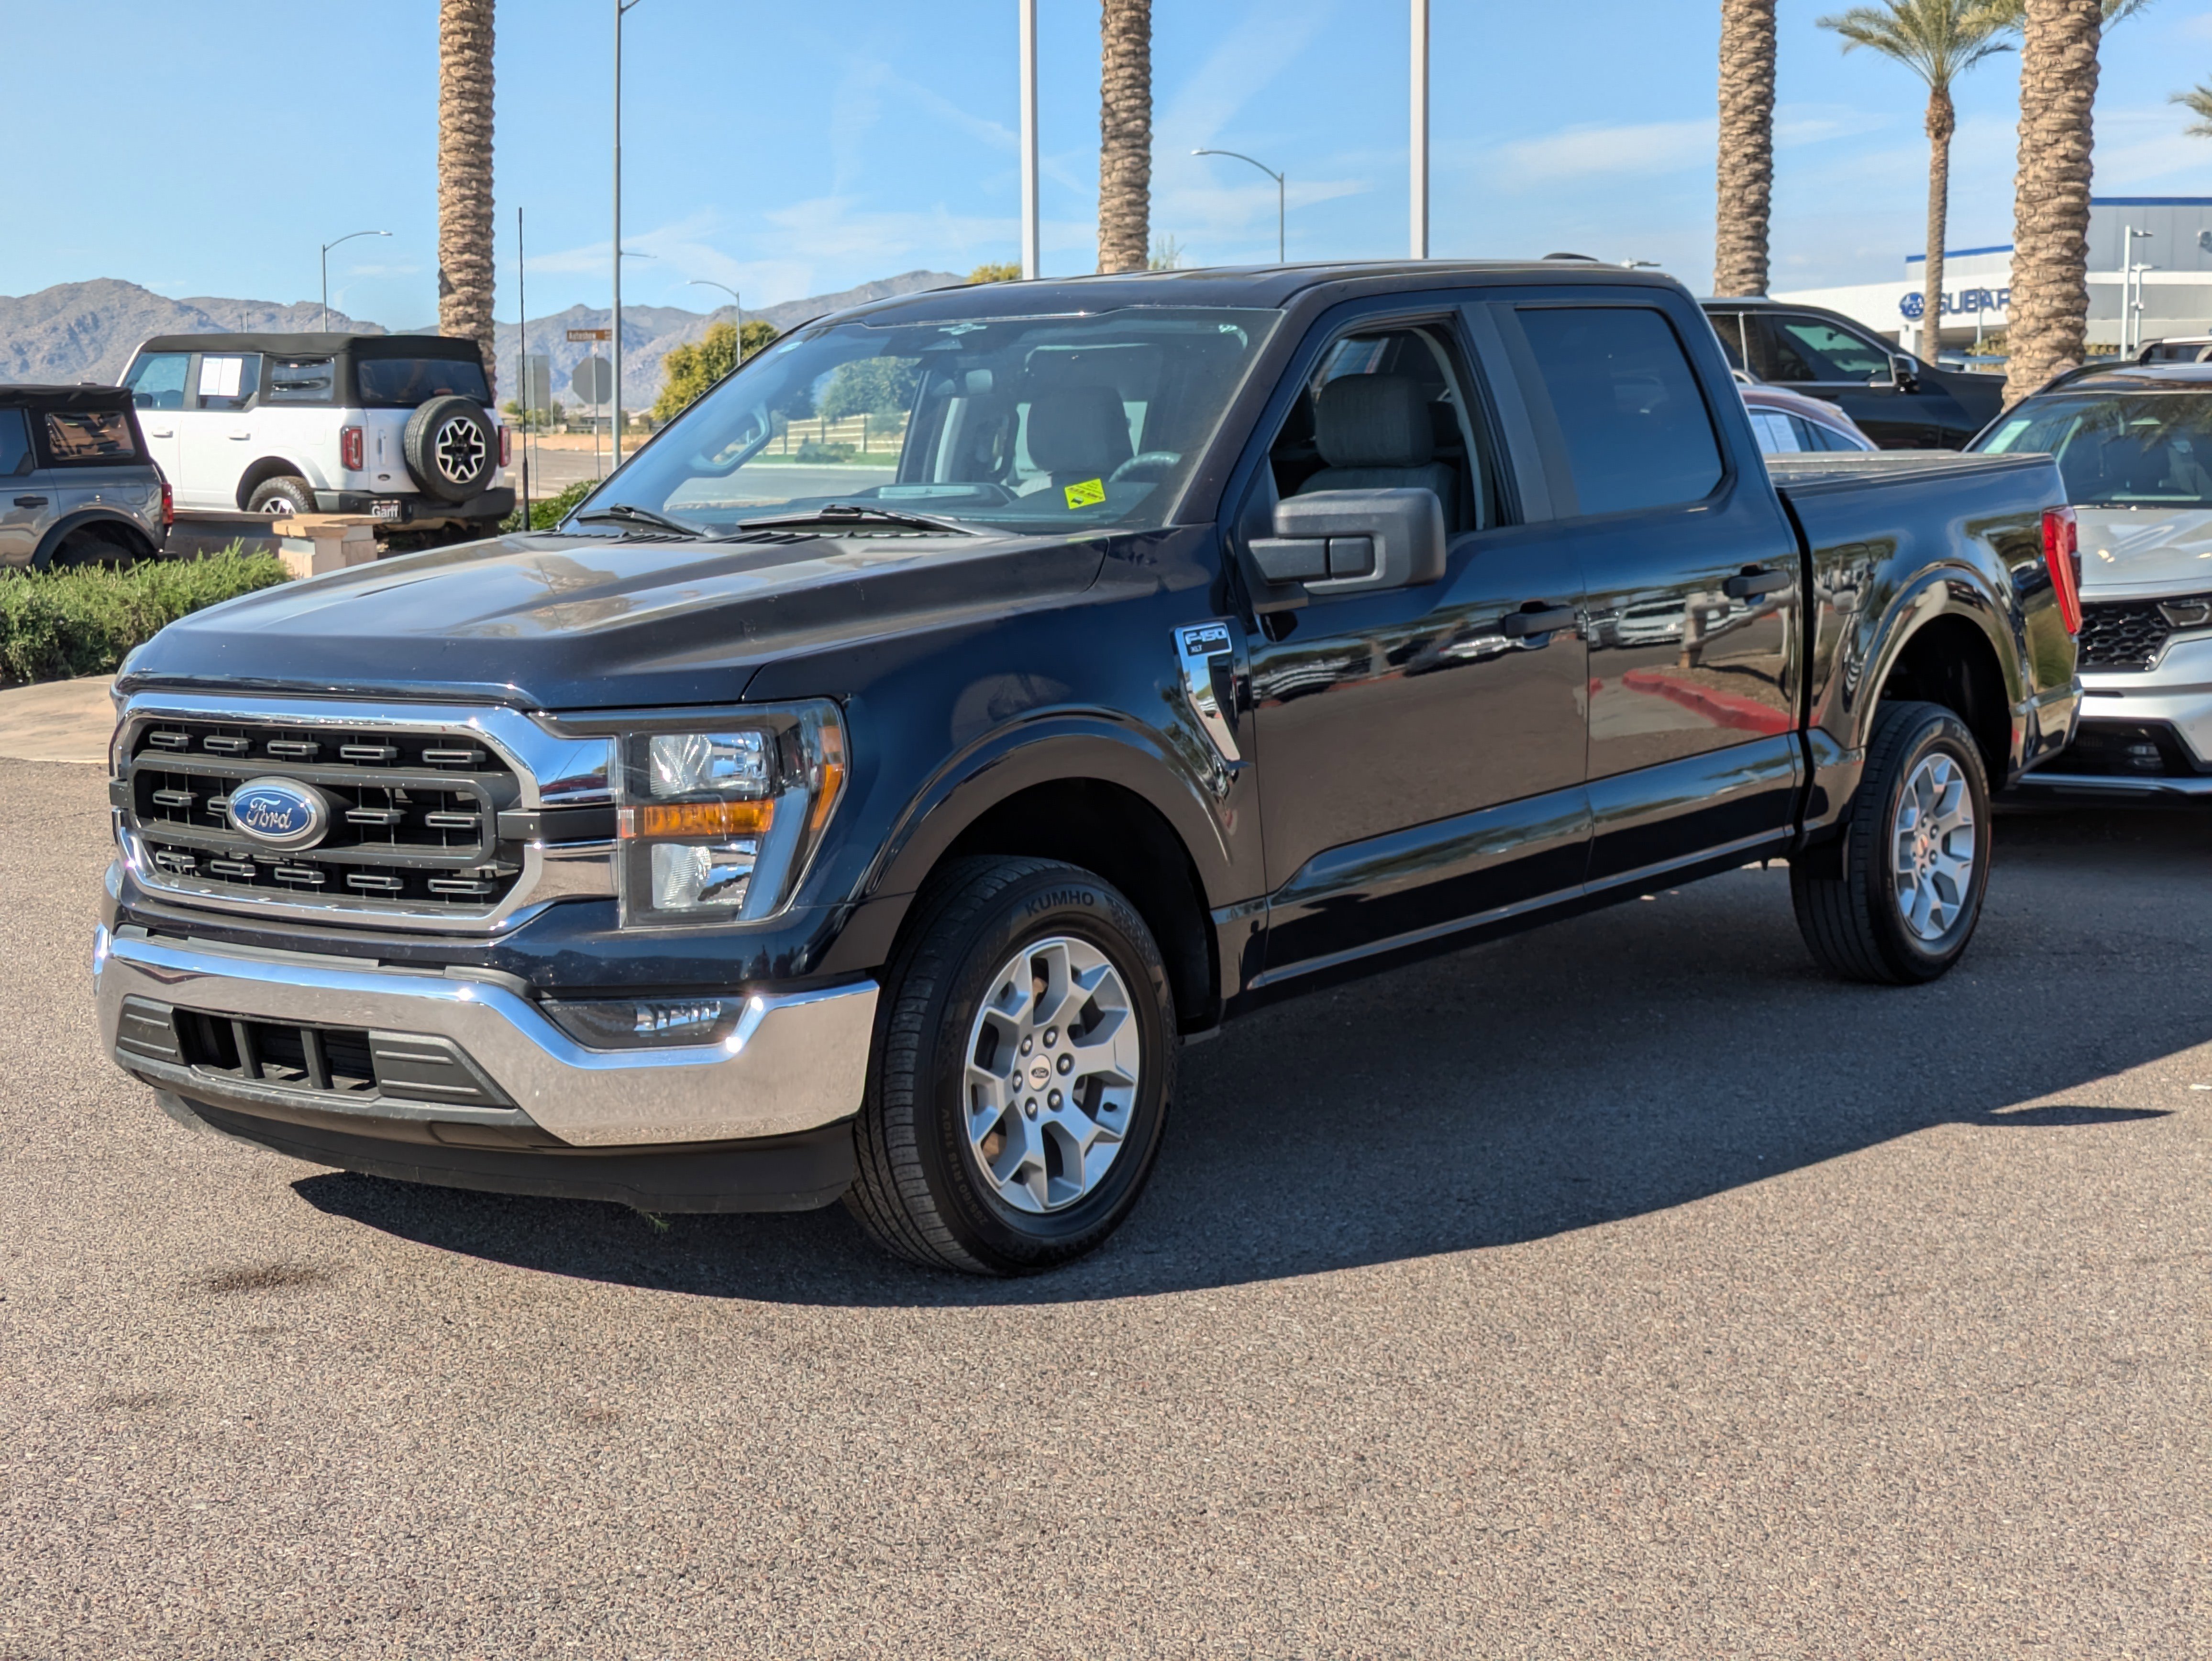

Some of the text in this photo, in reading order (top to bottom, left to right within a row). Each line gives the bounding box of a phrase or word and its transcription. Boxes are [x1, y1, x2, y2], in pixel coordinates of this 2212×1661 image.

[1184, 627, 1228, 645] F-150
[246, 797, 292, 829] Ford
[1025, 890, 1095, 918] KUMHO
[948, 1152, 963, 1182] R18
